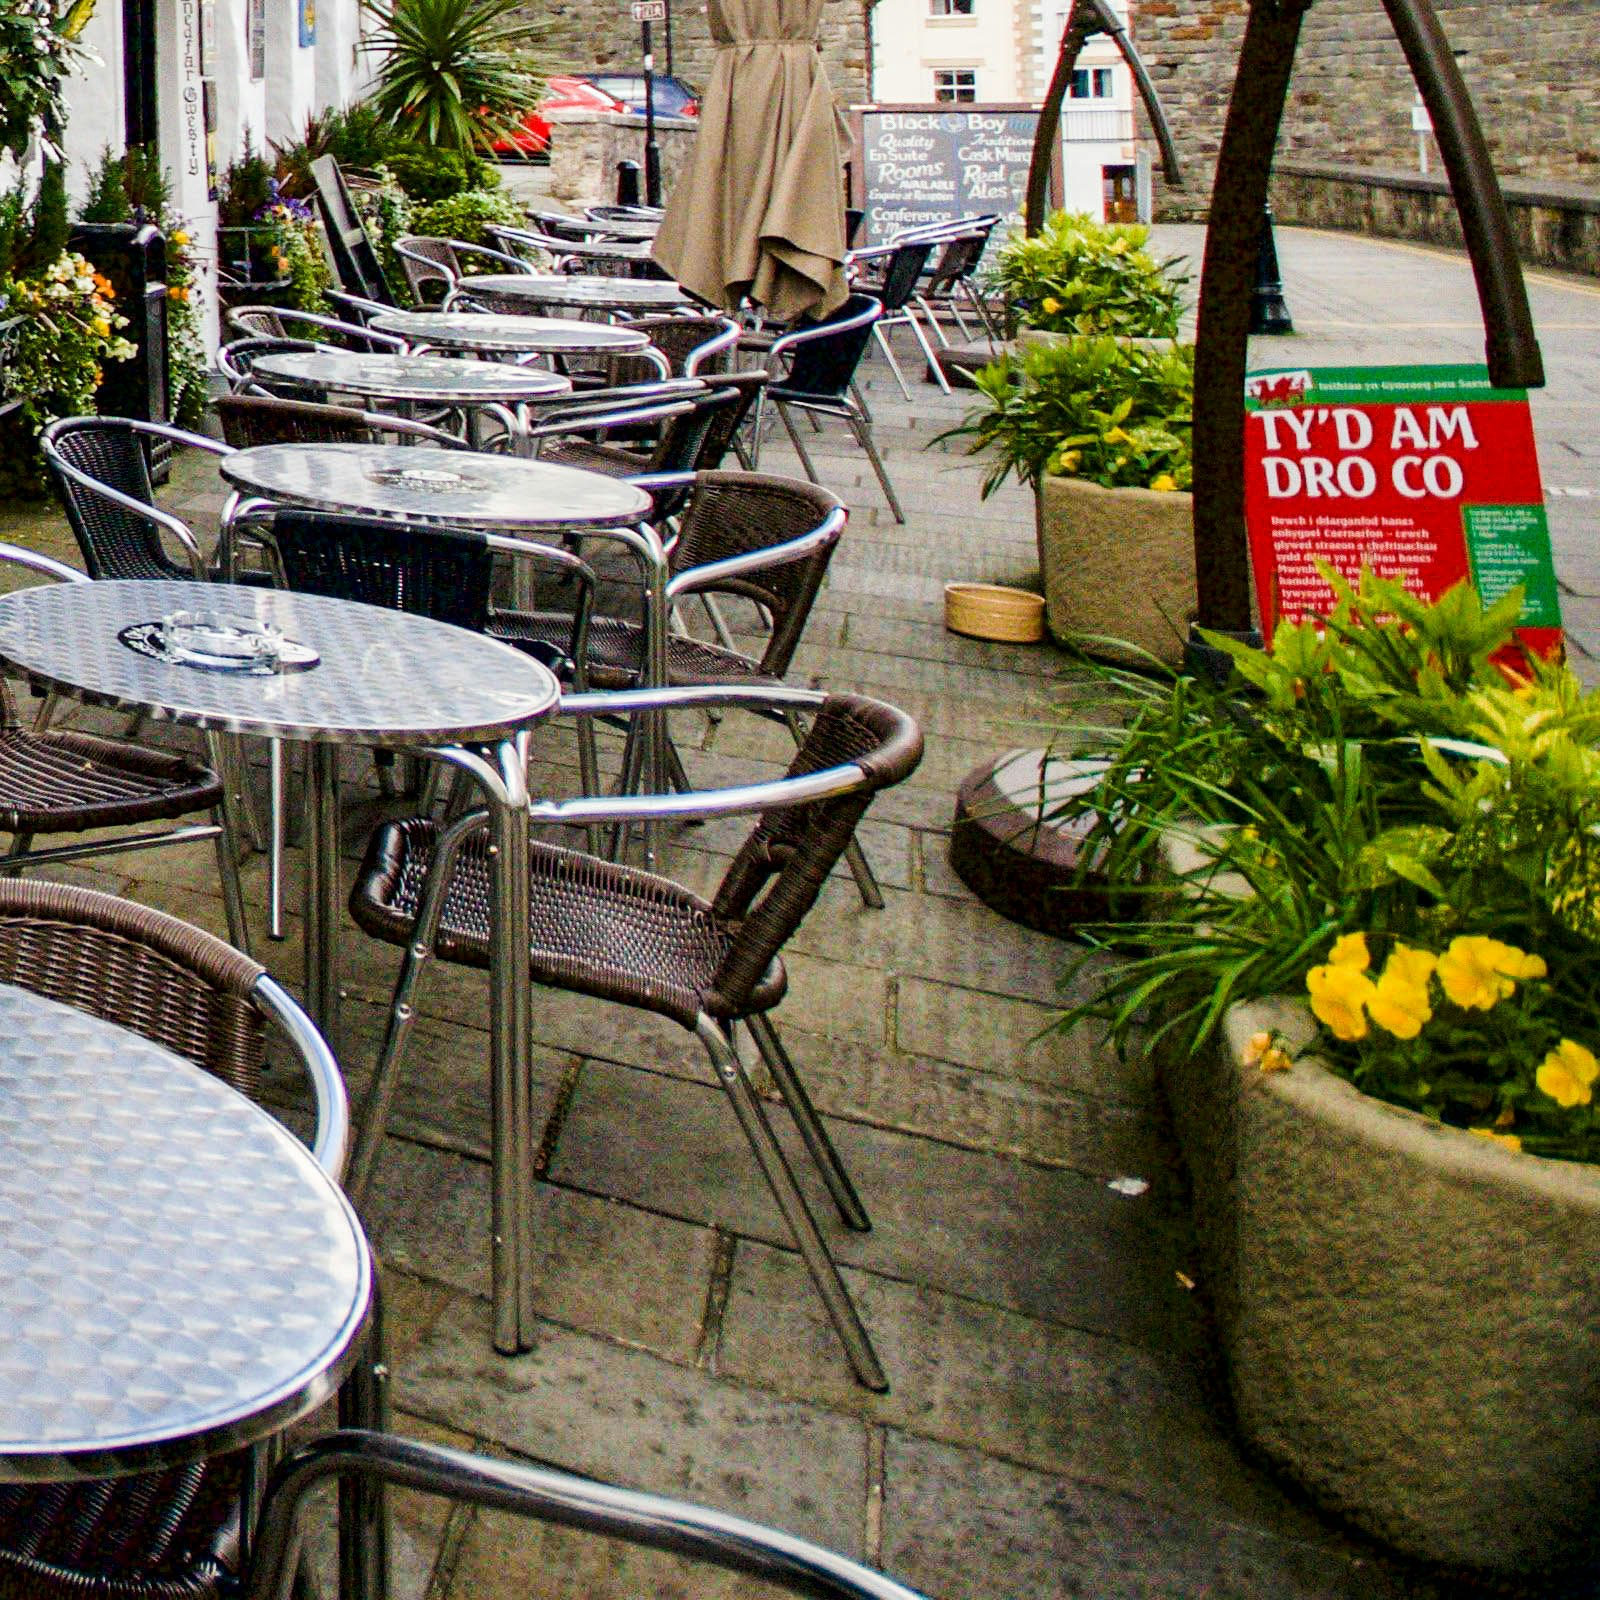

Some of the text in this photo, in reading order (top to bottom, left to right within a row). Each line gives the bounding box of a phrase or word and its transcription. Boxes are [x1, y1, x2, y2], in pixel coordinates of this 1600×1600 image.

[880, 113, 941, 131] Black
[967, 113, 1007, 135] Boy
[878, 132, 935, 151] Quality
[970, 132, 1035, 147] Tradition
[958, 147, 1032, 163] Cask Marq
[878, 161, 945, 184] Rooms
[963, 163, 1005, 185] Real
[899, 179, 956, 191] AVAILABLE
[968, 183, 1008, 200] Ales
[871, 206, 953, 222] Conference
[1251, 406, 1480, 450] TY'D AM
[1261, 455, 1464, 499] DRO CO
